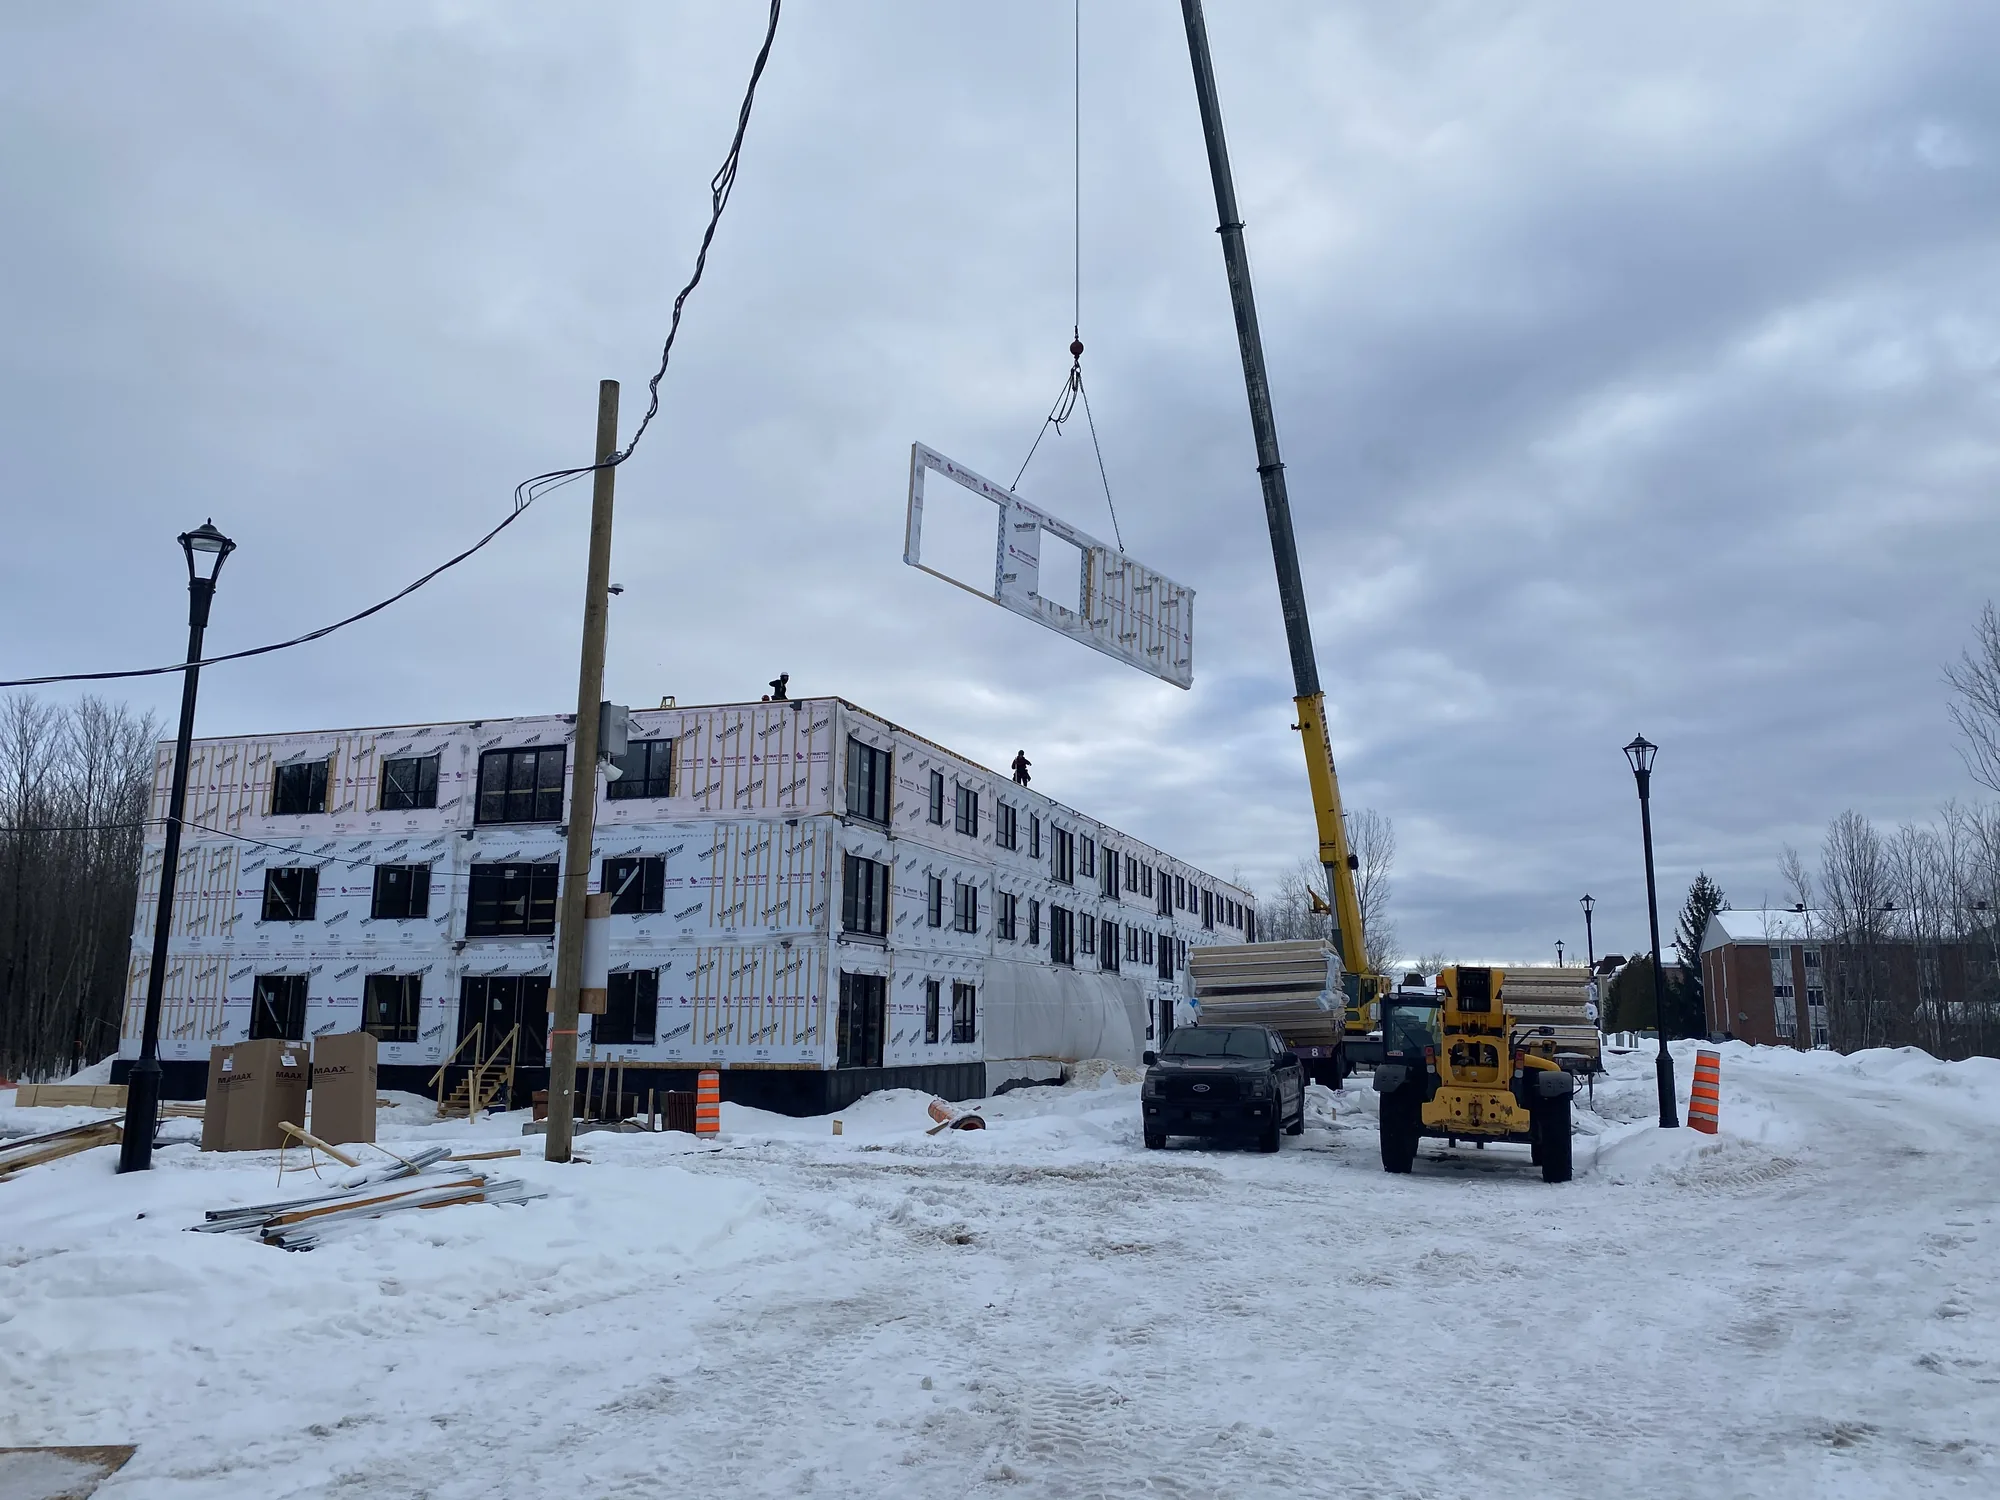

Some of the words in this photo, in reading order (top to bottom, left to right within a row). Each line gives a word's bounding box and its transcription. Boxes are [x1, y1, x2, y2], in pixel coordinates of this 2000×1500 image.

[661, 1022, 691, 1040] NovaWrap
[1311, 1048, 1318, 1057] 8
[276, 1071, 302, 1079] MAAX
[314, 1066, 346, 1075] MAAX
[230, 1072, 252, 1081] MAAX
